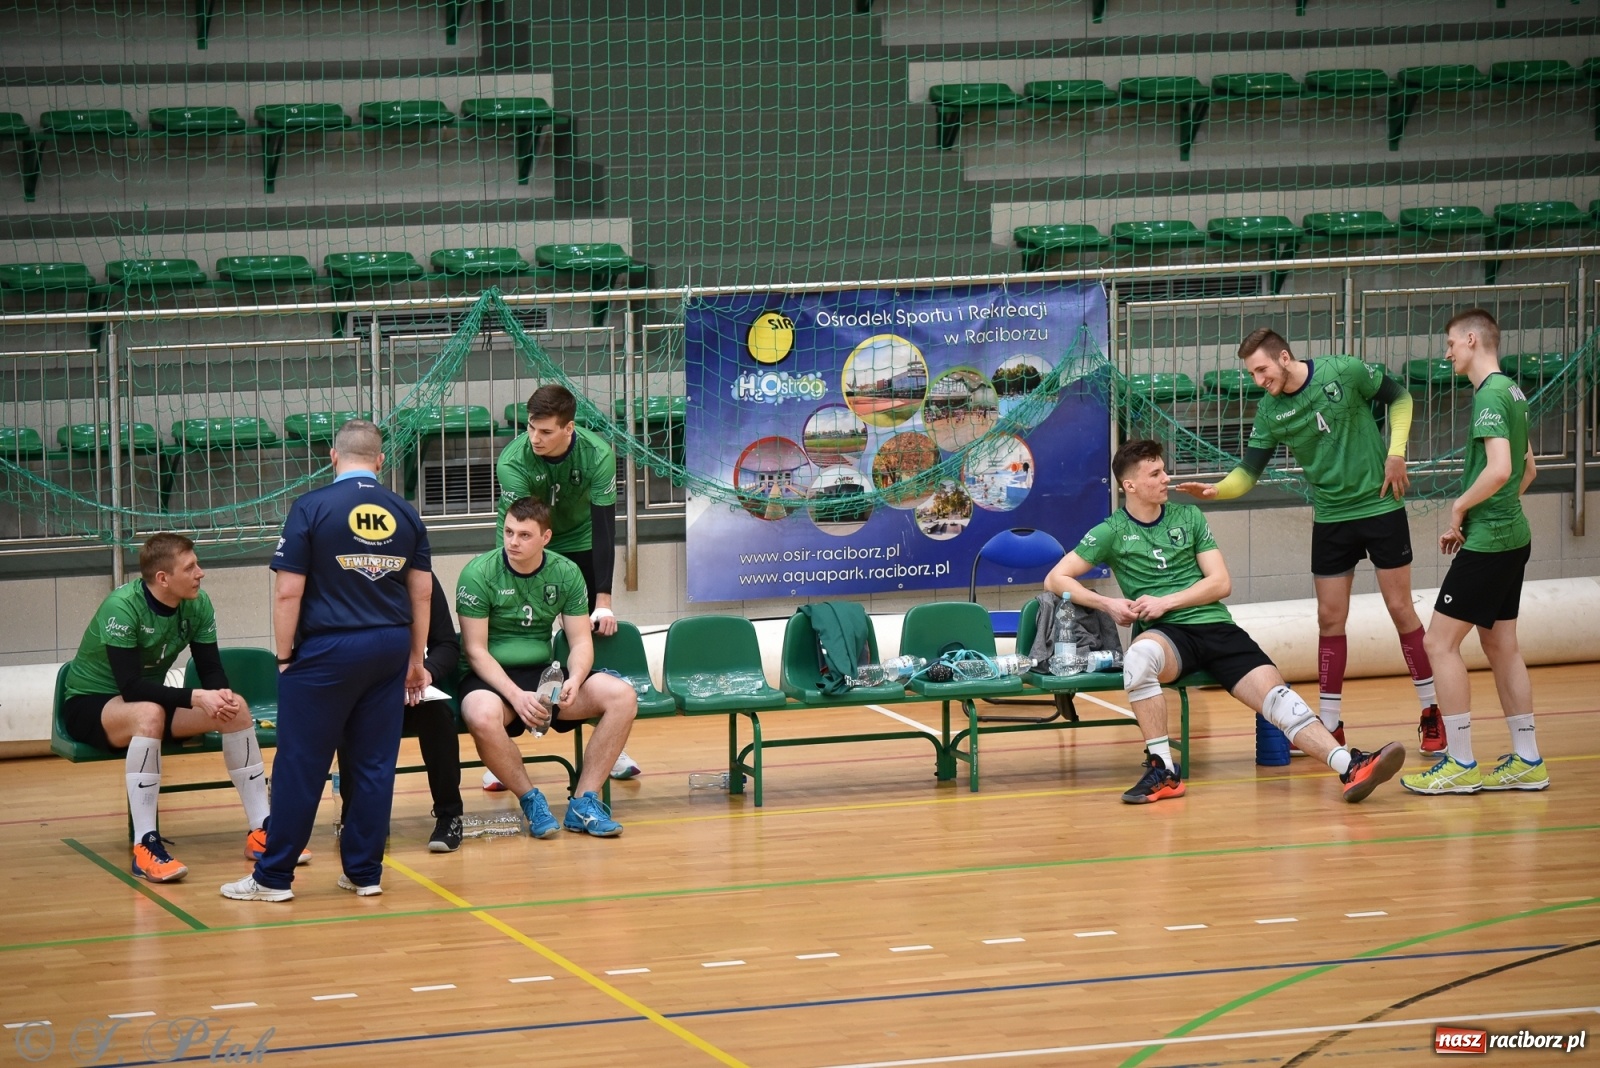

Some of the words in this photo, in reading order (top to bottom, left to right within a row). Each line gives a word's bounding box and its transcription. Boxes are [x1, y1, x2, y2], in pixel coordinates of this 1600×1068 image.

[816, 309, 891, 327] Ośrodek
[895, 307, 953, 328] Sportu
[958, 305, 964, 321] i
[968, 301, 1048, 321] Rekreacji
[943, 333, 959, 345] w
[965, 327, 1048, 345] Raciborzu
[1315, 411, 1331, 434] 4
[1474, 407, 1504, 427] Jura
[355, 512, 390, 532] HK
[738, 543, 901, 565] www.osir-raciborz.pl
[1152, 548, 1168, 570] 5
[738, 560, 951, 585] www.aquapark.raciborz.pl
[105, 616, 132, 635] Jura
[521, 604, 534, 627] 3
